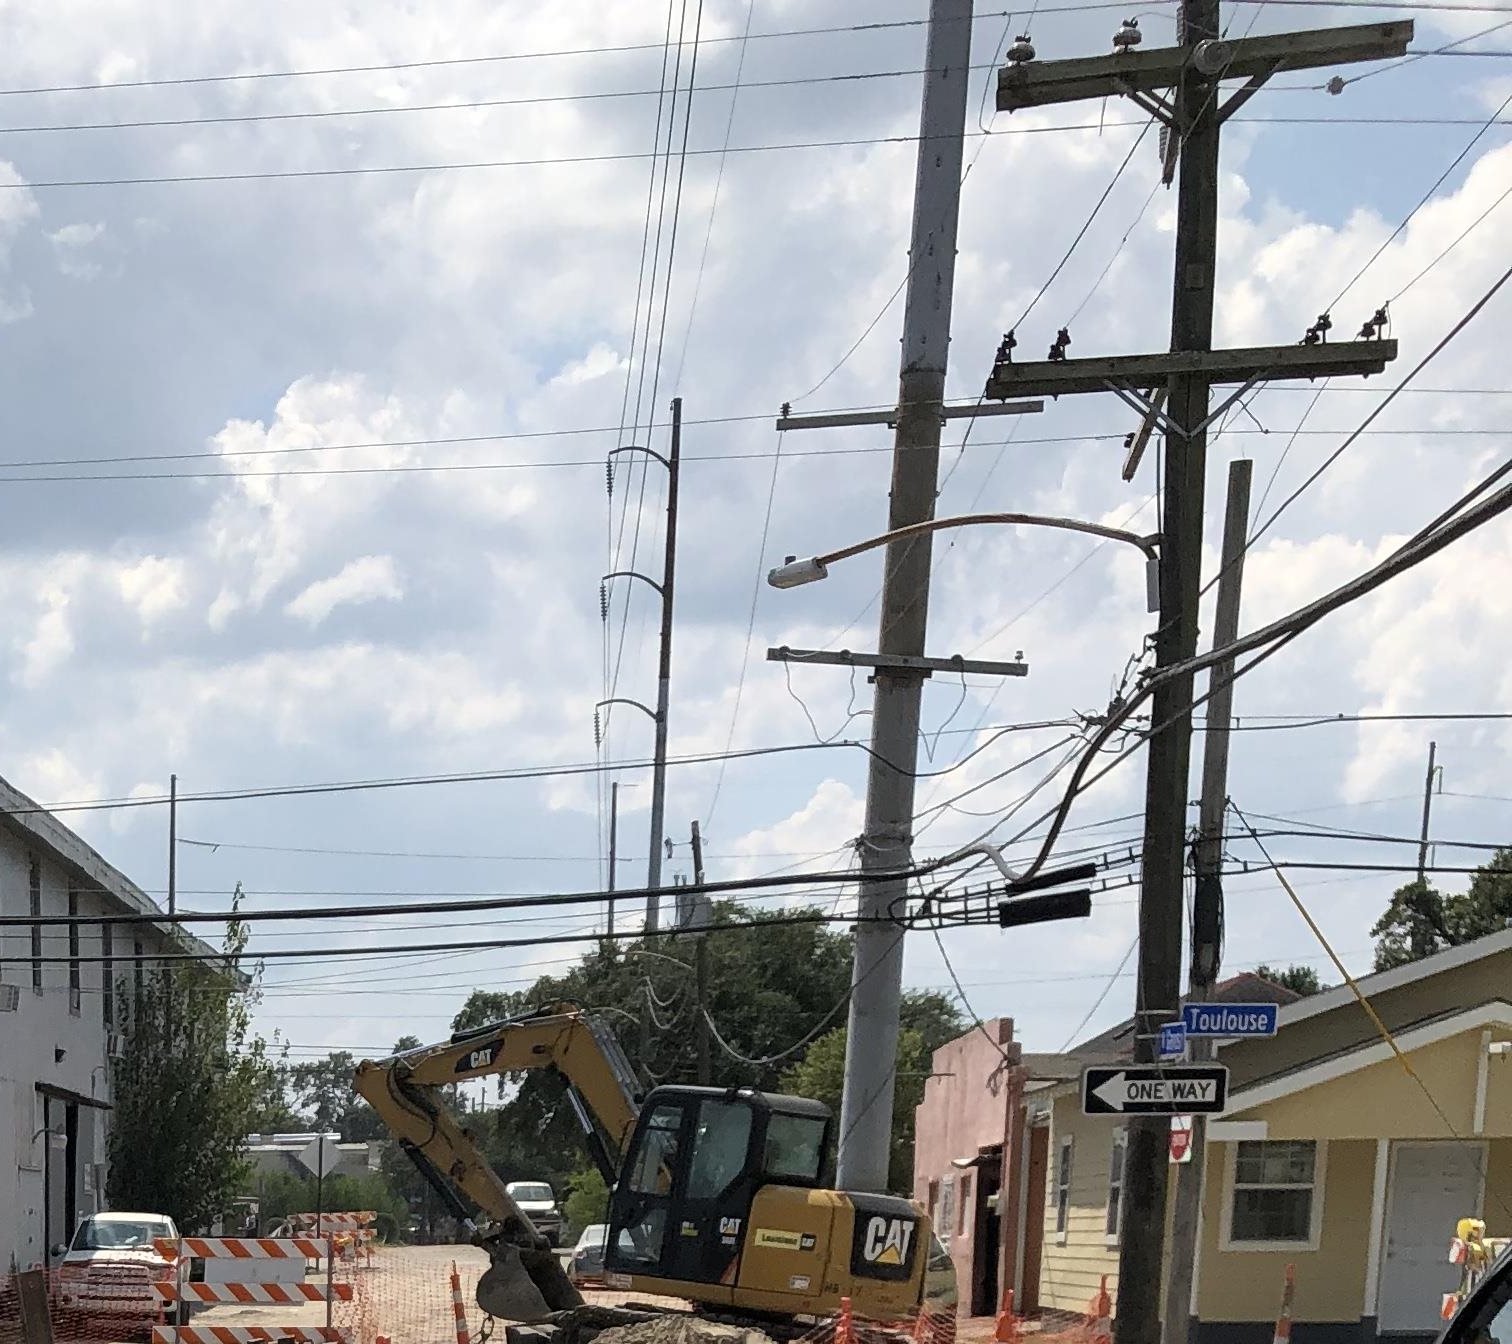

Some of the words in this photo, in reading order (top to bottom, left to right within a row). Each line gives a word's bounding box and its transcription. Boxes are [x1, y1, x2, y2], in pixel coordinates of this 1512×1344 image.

[1190, 1008, 1268, 1031] Toulouse
[470, 1049, 492, 1068] CAT
[1127, 1082, 1165, 1100] ONE
[1172, 1081, 1211, 1099] WAY
[720, 1217, 741, 1234] CAT
[864, 1216, 915, 1265] CAT
